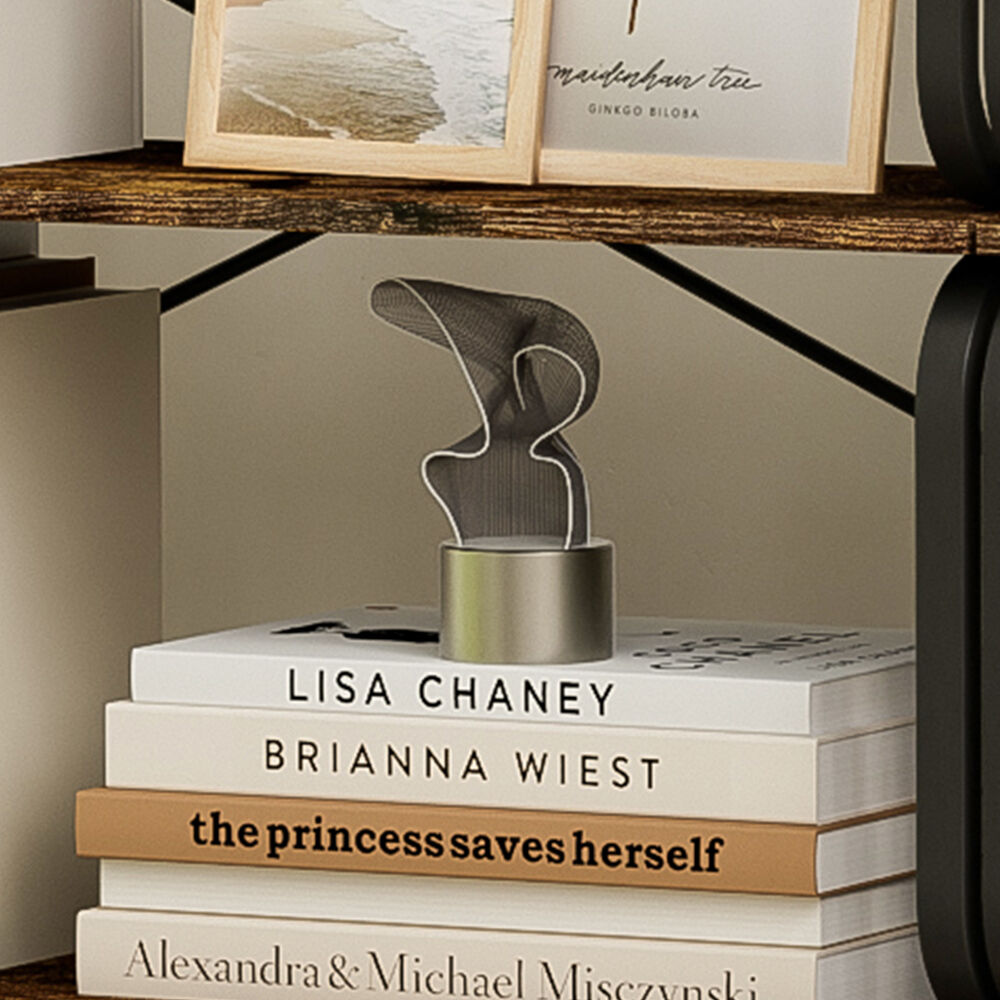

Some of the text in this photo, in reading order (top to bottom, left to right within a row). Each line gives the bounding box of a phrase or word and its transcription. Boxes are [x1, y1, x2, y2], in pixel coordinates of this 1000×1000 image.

[548, 59, 762, 91] maidenhair tree
[588, 103, 699, 119] GINKGO BILOBA
[289, 668, 615, 717] LISA CHANEY
[265, 739, 660, 789] BRIANNA WIEST
[124, 938, 321, 989] Alexandra
[366, 950, 524, 999] Michael
